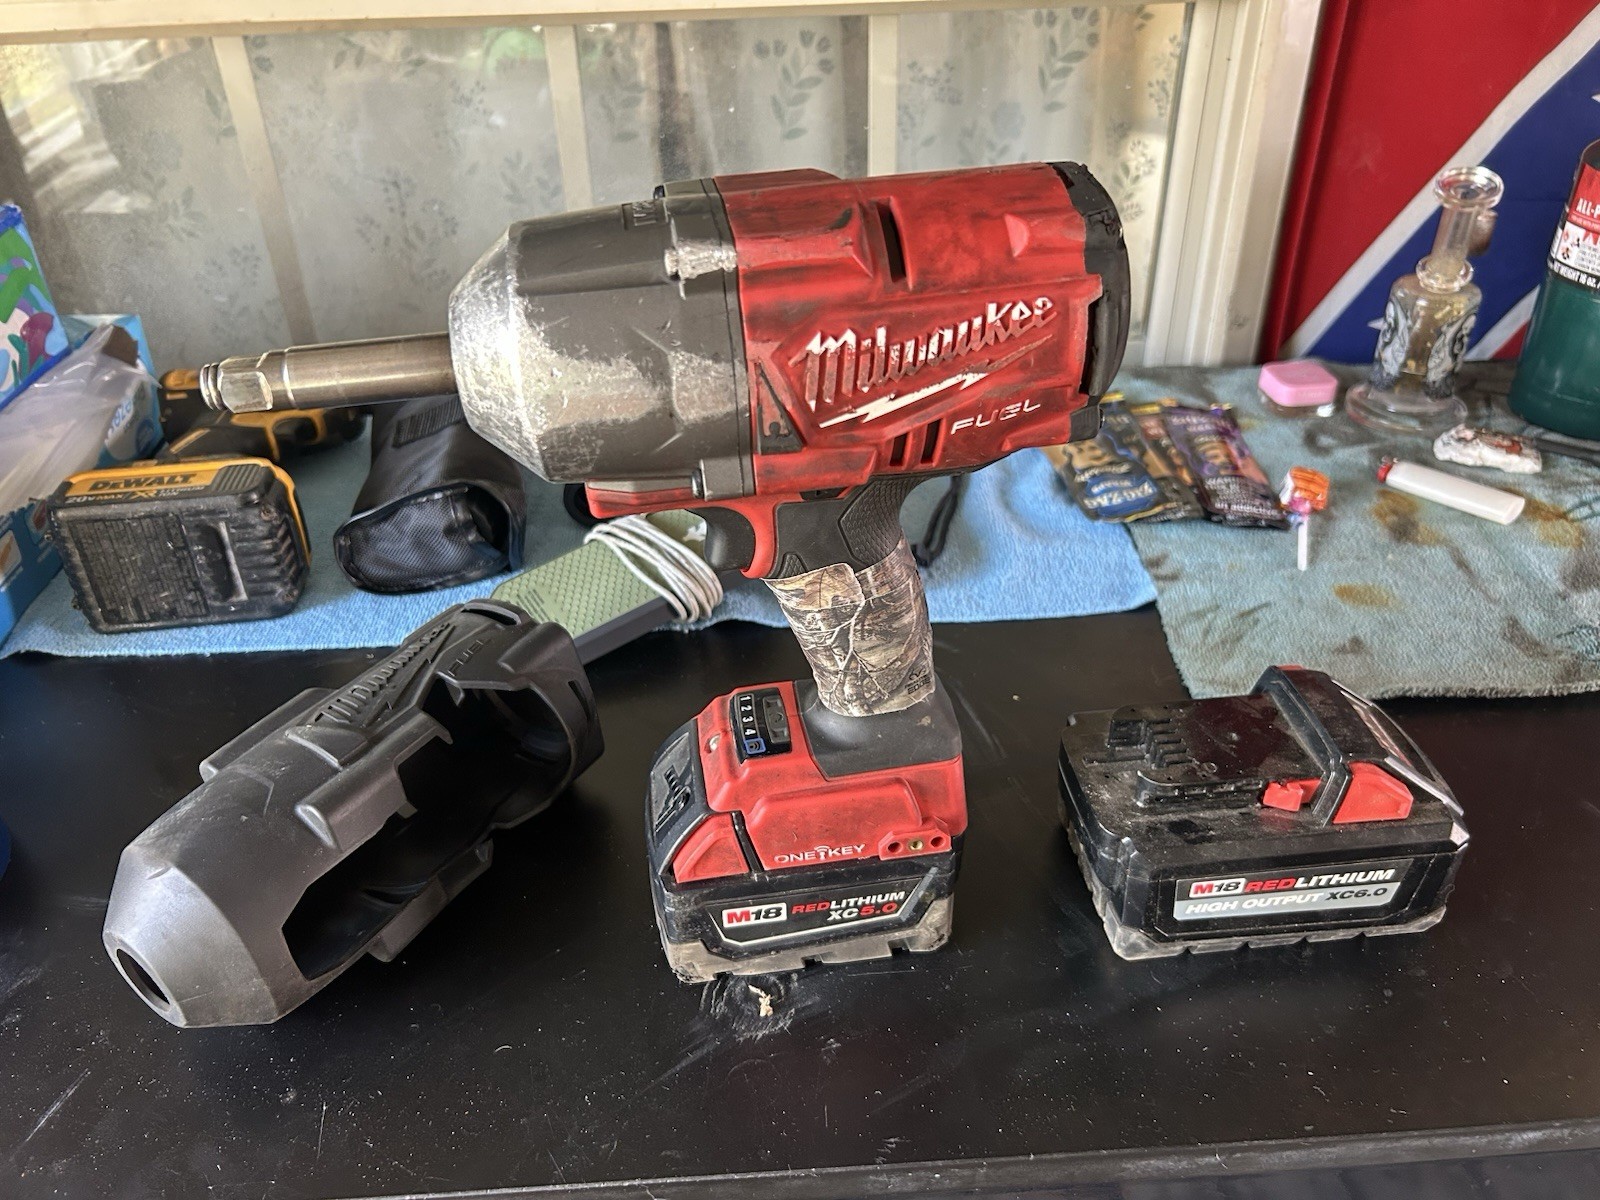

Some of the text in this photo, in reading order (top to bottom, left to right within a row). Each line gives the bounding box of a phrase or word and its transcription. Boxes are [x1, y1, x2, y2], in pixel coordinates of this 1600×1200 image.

[788, 297, 1057, 413] Milwaukee
[951, 400, 1041, 434] FUEL
[742, 715, 754, 723] 3
[744, 728, 757, 736] 4
[1193, 868, 1396, 895] M18 REDLITHIUM
[726, 891, 906, 924] M18 REDLITHIUM
[826, 902, 898, 921] XC5.0
[1185, 886, 1388, 914] HIGH OUTPUT XC6.0
